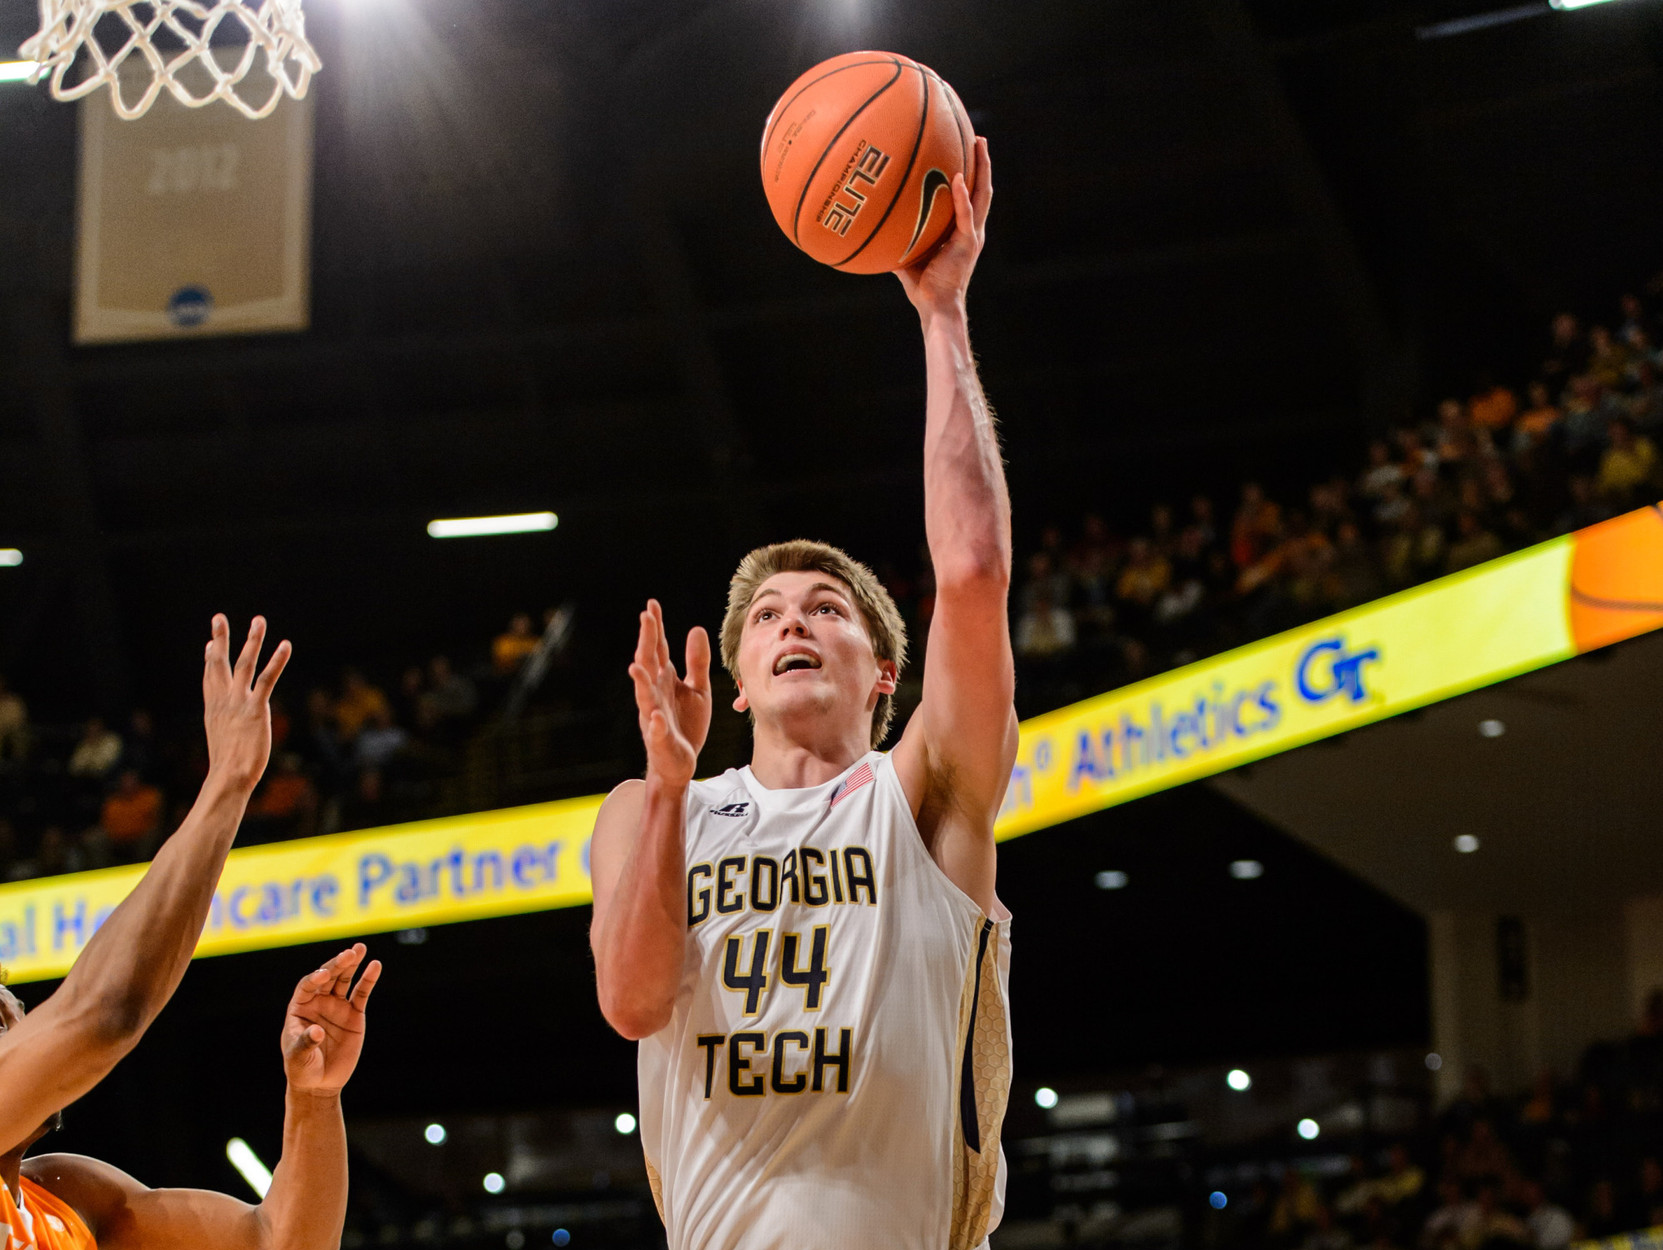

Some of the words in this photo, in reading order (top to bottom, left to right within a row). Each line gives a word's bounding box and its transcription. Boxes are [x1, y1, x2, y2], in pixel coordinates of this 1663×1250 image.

[816, 139, 867, 222] CHAMPIONSHIP
[822, 145, 891, 238] ELITE
[1066, 682, 1280, 794] Athletics
[359, 842, 561, 909] Partner
[687, 846, 878, 928] GEORGIA
[721, 924, 831, 1017] 44
[697, 1027, 853, 1101] TECH
